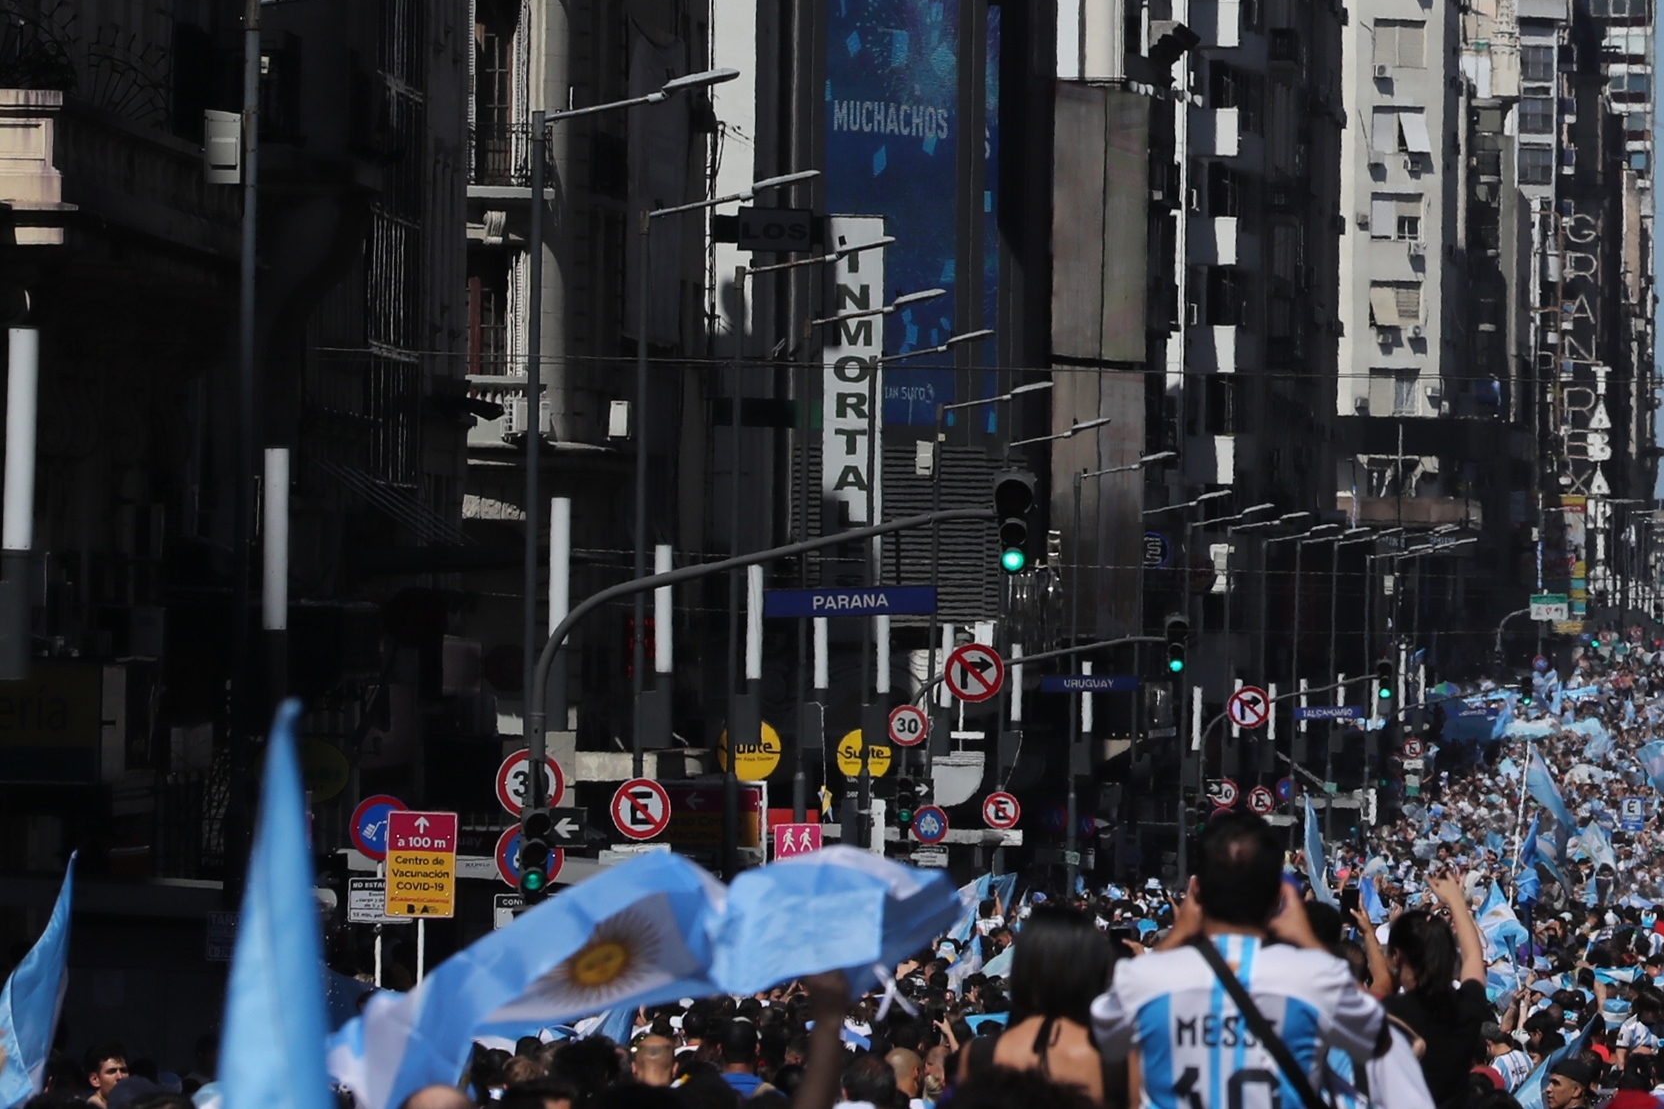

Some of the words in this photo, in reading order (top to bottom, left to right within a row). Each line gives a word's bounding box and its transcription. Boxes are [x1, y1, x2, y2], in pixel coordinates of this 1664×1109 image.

[833, 99, 949, 140] MUCHACHOS
[741, 222, 808, 241] LOS
[812, 593, 889, 611] PARANA
[896, 717, 919, 735] 30
[844, 745, 884, 759] Sute
[397, 838, 405, 847] a
[408, 836, 431, 847] 100
[434, 838, 446, 848] m
[395, 855, 430, 866] Centro
[432, 856, 445, 866] de
[391, 868, 450, 879] Vacunación
[352, 881, 364, 889] NO
[396, 881, 445, 891] COVID-19
